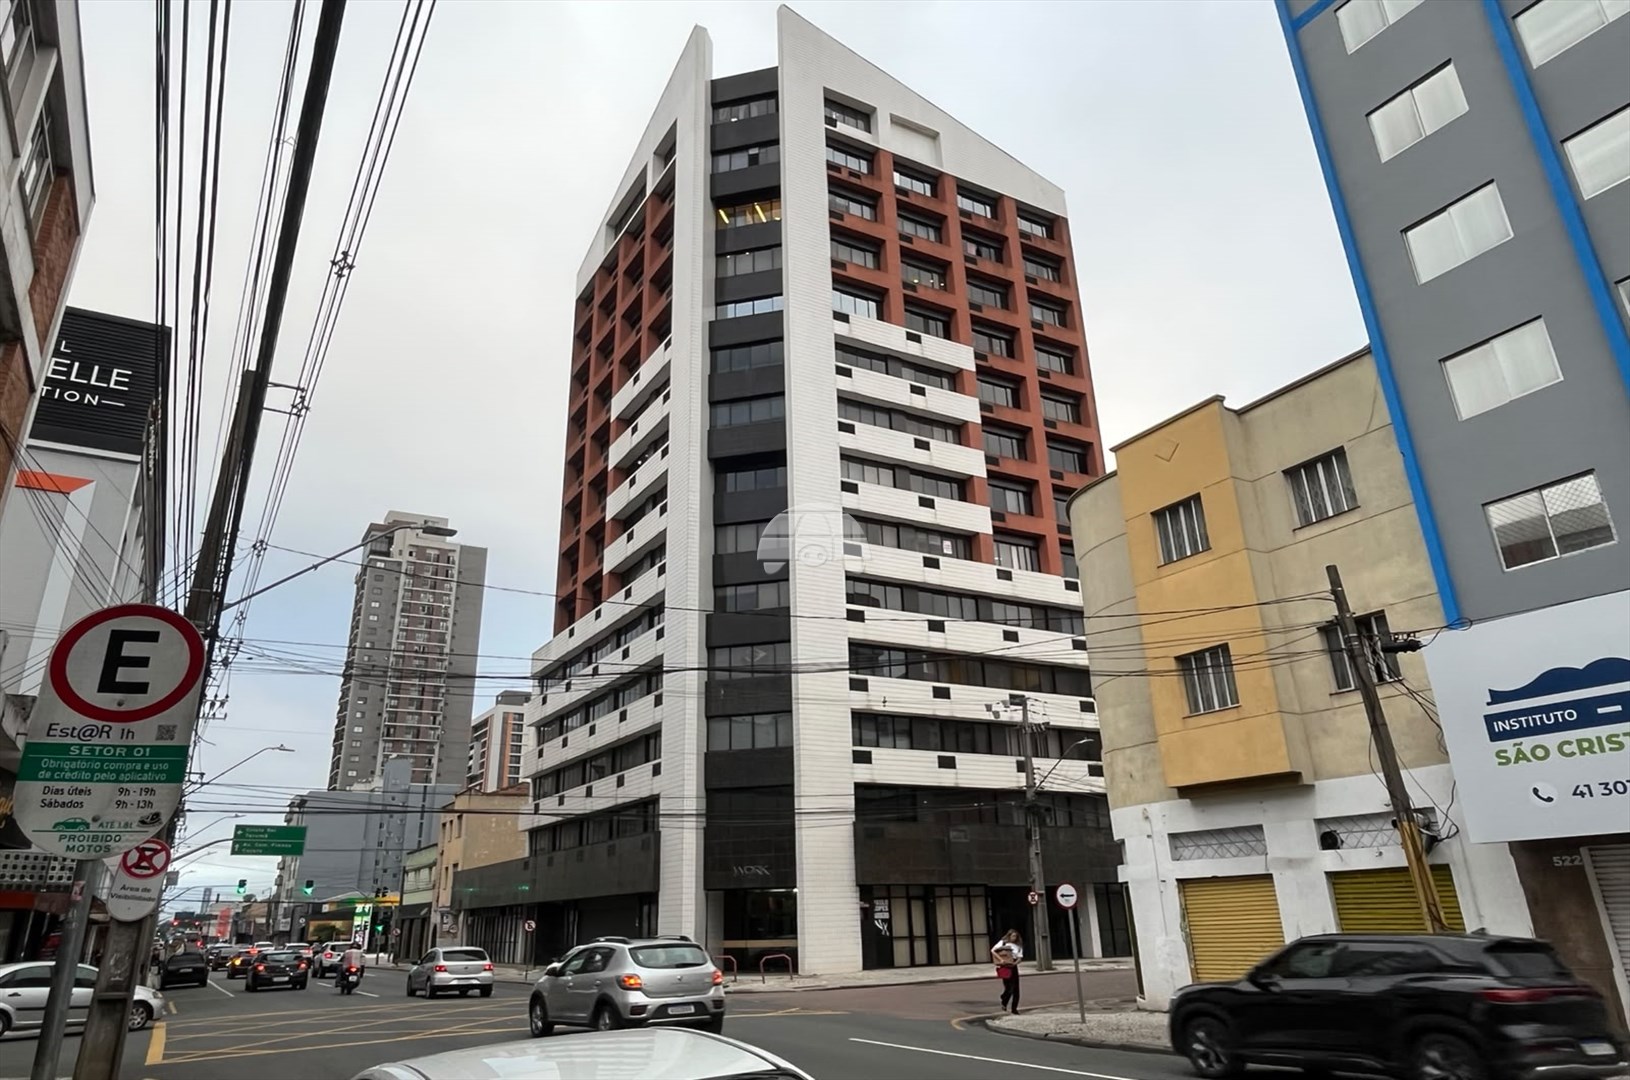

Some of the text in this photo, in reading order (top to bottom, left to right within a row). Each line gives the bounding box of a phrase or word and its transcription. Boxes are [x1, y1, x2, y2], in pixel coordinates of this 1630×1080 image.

[97, 629, 161, 695] E
[1493, 709, 1578, 733] INSTITUTO
[46, 722, 113, 742] Est@R
[69, 745, 151, 757] SETOR 01
[1495, 741, 1551, 766] SÃO
[41, 758, 169, 771] Obrigatório compra e uso
[38, 768, 167, 782] de crédito pelo aplicativo
[42, 785, 65, 796] Dias
[67, 786, 92, 796] úteis
[117, 787, 130, 797] 9h
[139, 787, 156, 797] 19h
[1571, 784, 1595, 799] 41
[40, 798, 84, 809] Sábados
[115, 799, 128, 809] 9h
[136, 800, 153, 809] 13h
[58, 834, 122, 843] PROIBIDO
[65, 844, 111, 853] MOTOS
[1552, 855, 1583, 867] 522
